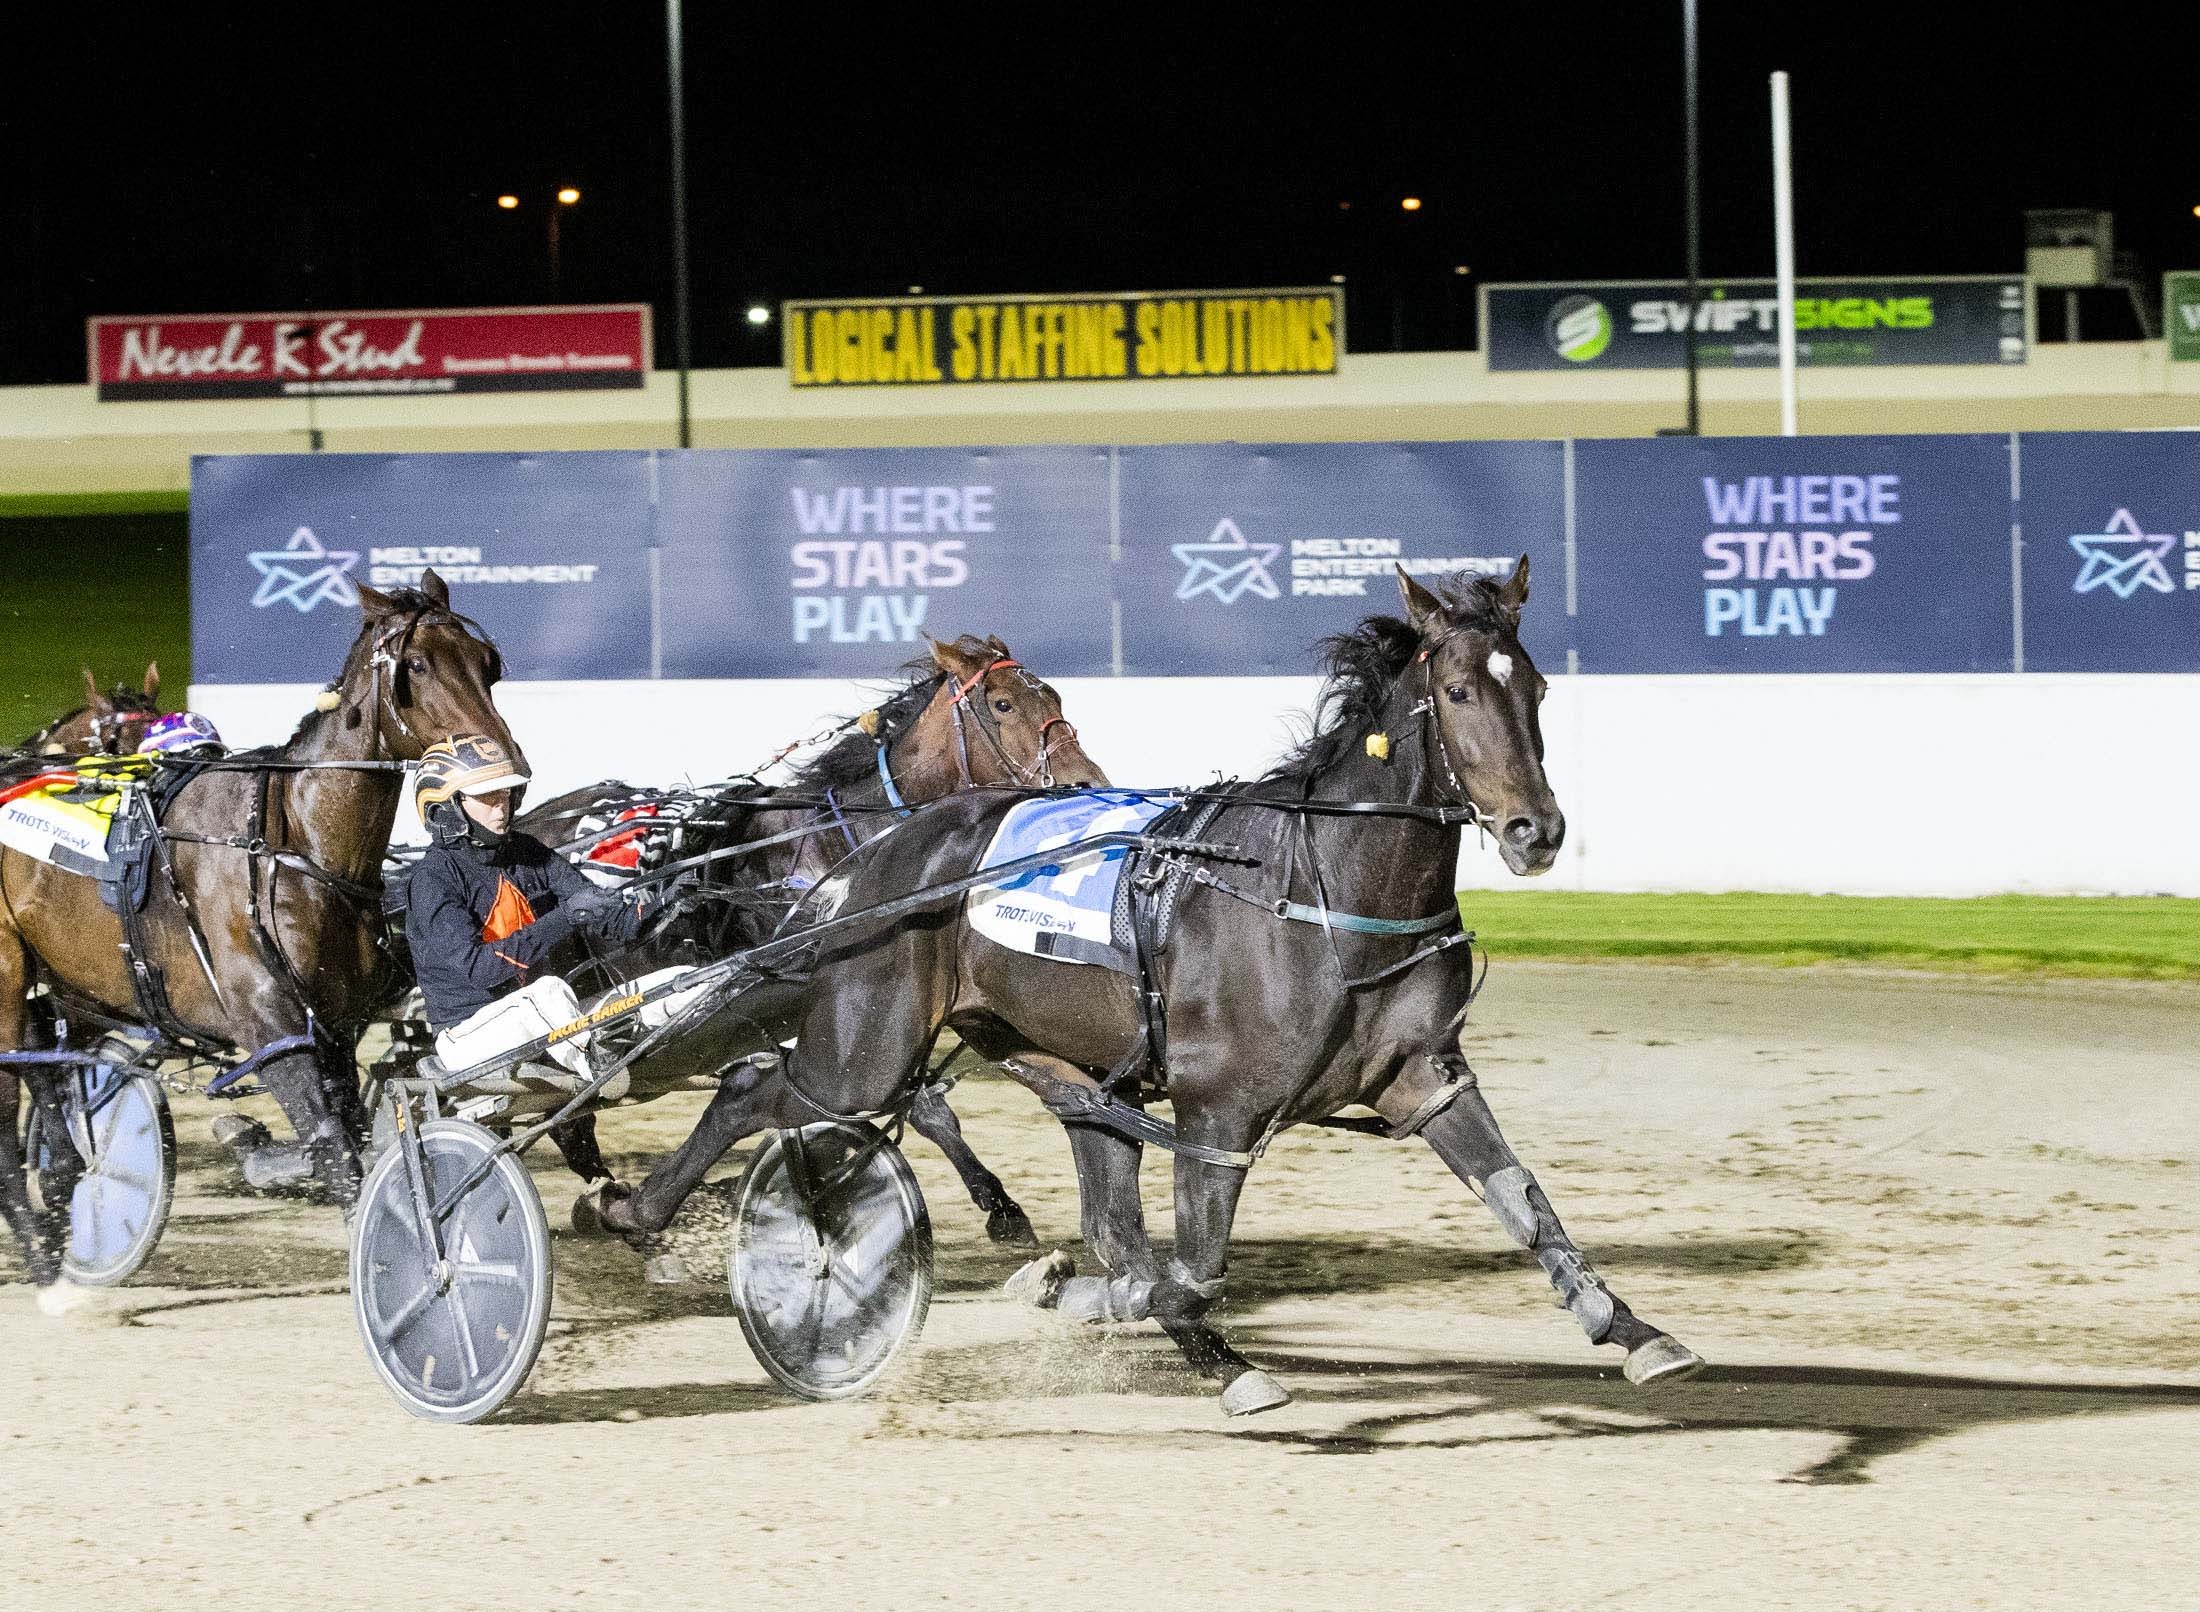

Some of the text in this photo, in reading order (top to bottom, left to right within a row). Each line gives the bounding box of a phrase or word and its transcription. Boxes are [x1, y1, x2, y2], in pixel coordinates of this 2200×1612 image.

[119, 323, 262, 379] Nevele
[317, 320, 425, 375] Stud
[794, 297, 1336, 384] LOGICAL STAFFING SOLUTIONS
[791, 485, 996, 534] WHERE
[1702, 474, 1900, 525] WHERE
[369, 546, 482, 564] MELTON
[791, 540, 969, 588] STARS
[1291, 538, 1401, 557] MELTON
[1702, 531, 1876, 581] STARS
[1291, 577, 1368, 597] PARK
[1705, 587, 1838, 637] PLAY
[793, 594, 929, 644] PLAY
